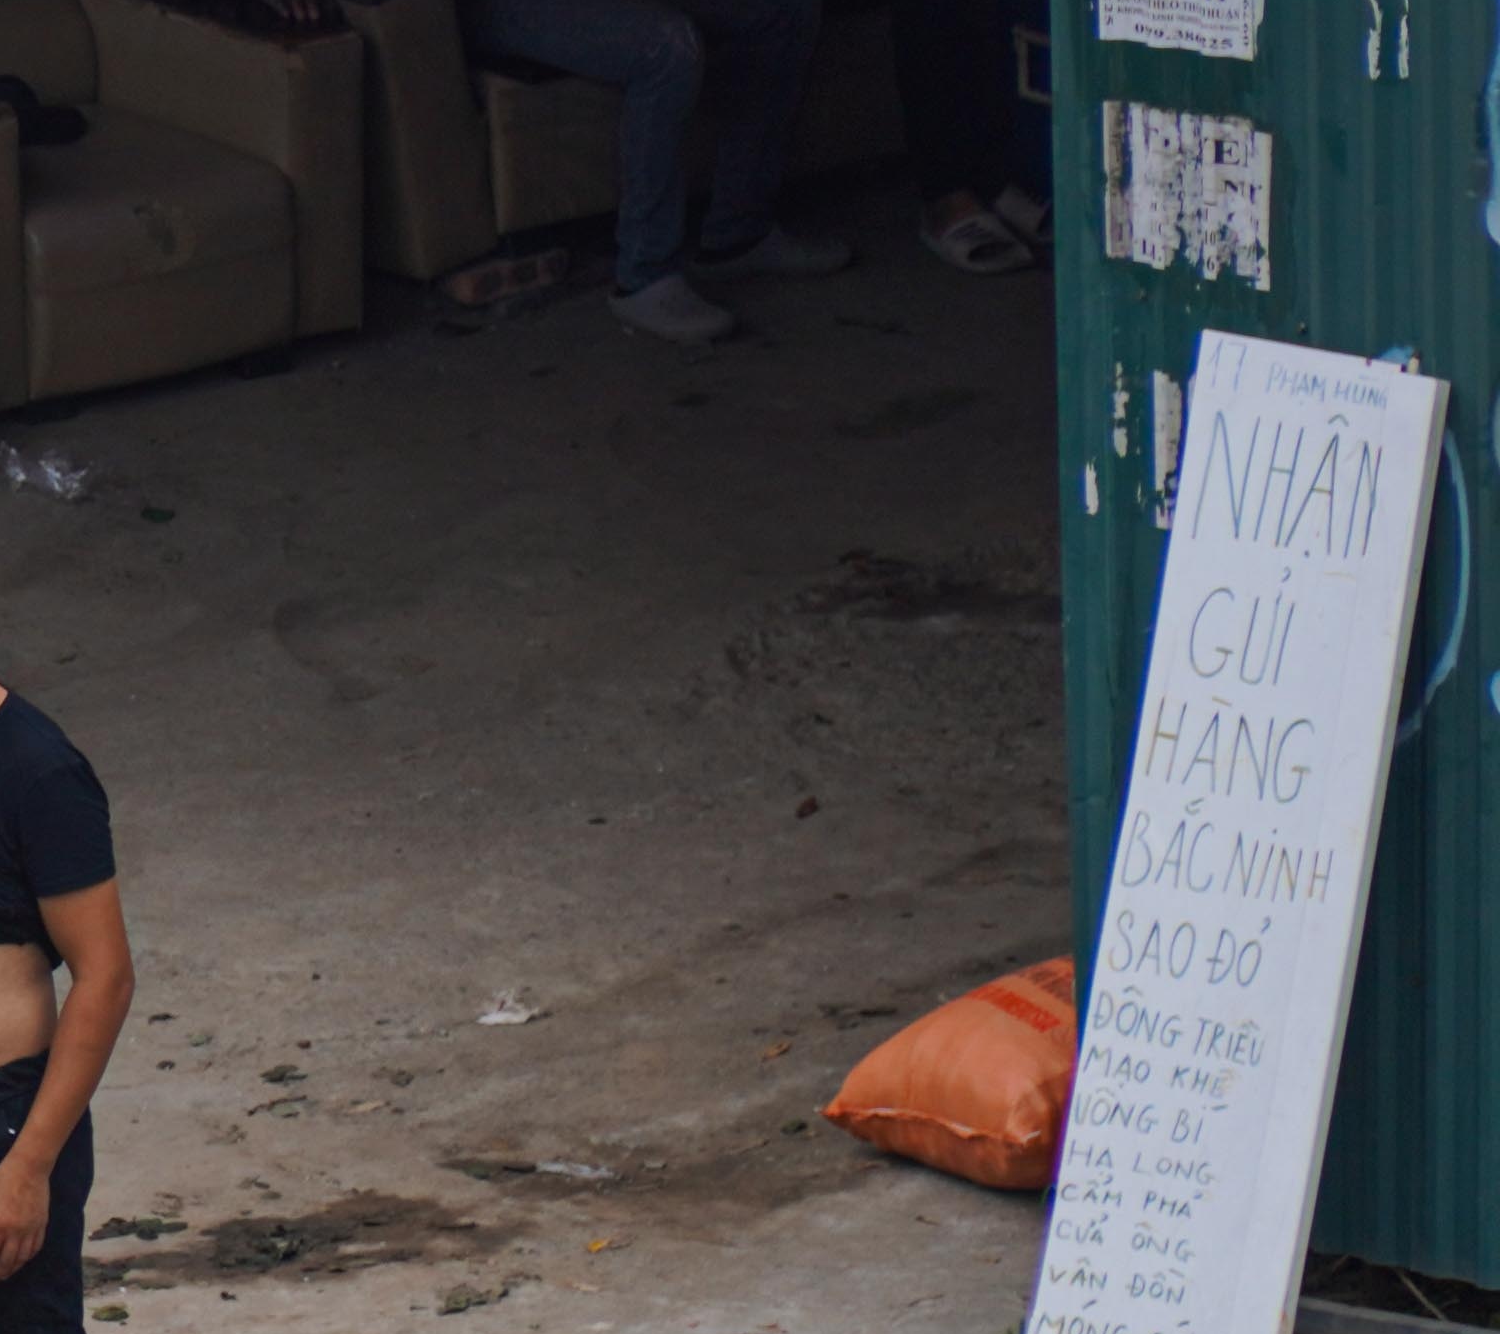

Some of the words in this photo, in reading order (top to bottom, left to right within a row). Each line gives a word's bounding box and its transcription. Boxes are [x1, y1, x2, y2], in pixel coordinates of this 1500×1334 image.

[1208, 339, 1248, 392] 17
[1190, 409, 1384, 561] NHẬN
[1145, 694, 1315, 805] HÀNG
[1119, 797, 1216, 894] BẮC
[1106, 909, 1198, 980] SAO
[1205, 914, 1275, 988] ĐỎ
[1092, 983, 1184, 1050] ĐÔNG
[1082, 1043, 1152, 1090] MẠO
[1131, 1151, 1220, 1187] LONG
[1130, 1219, 1197, 1264] ÔNG
